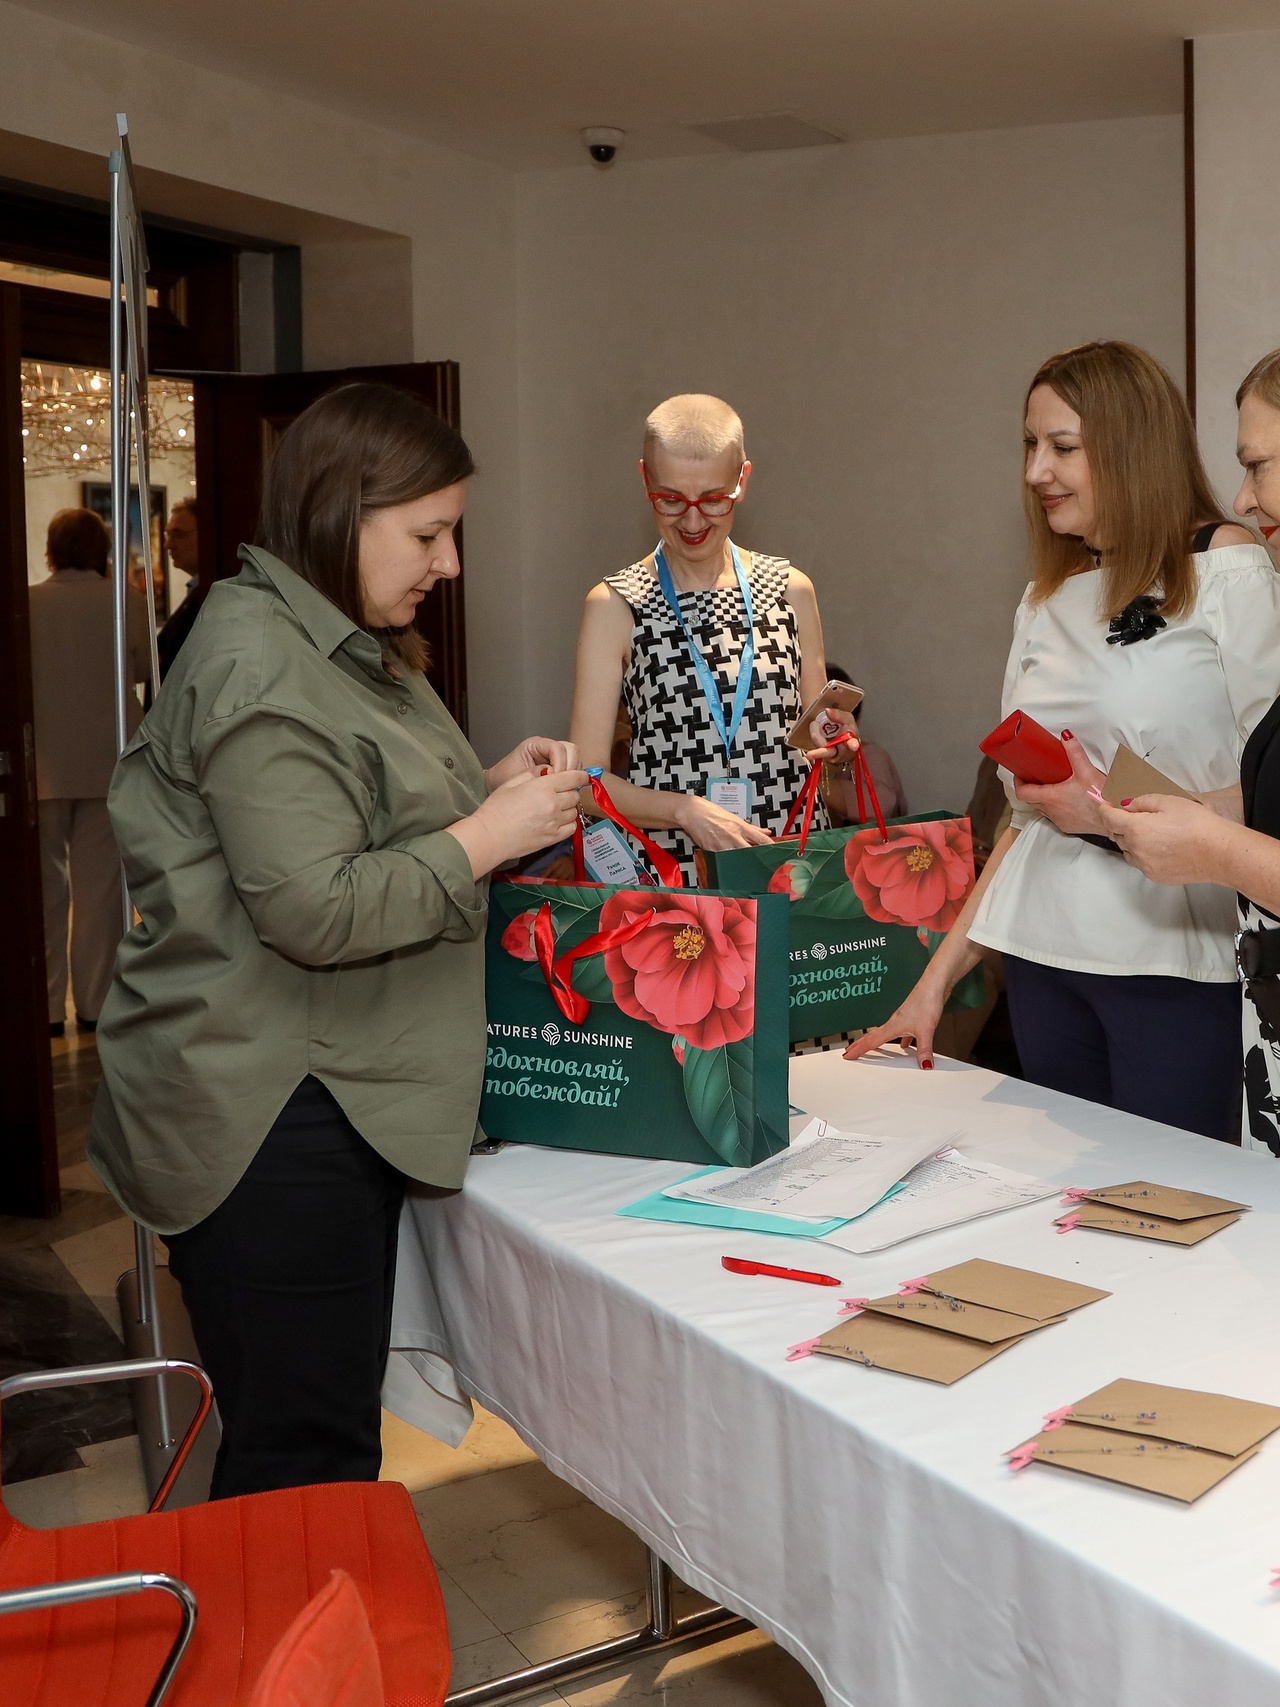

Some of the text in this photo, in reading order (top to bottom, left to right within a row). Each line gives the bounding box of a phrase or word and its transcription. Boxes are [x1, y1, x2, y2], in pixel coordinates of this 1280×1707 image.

[829, 936, 887, 955] SUNSHINE
[789, 955, 888, 987] охновляй,
[789, 976, 882, 1008] беждай!
[486, 1023, 634, 1049] ATURES SUNSHINE
[485, 1076, 621, 1108] побеждай!
